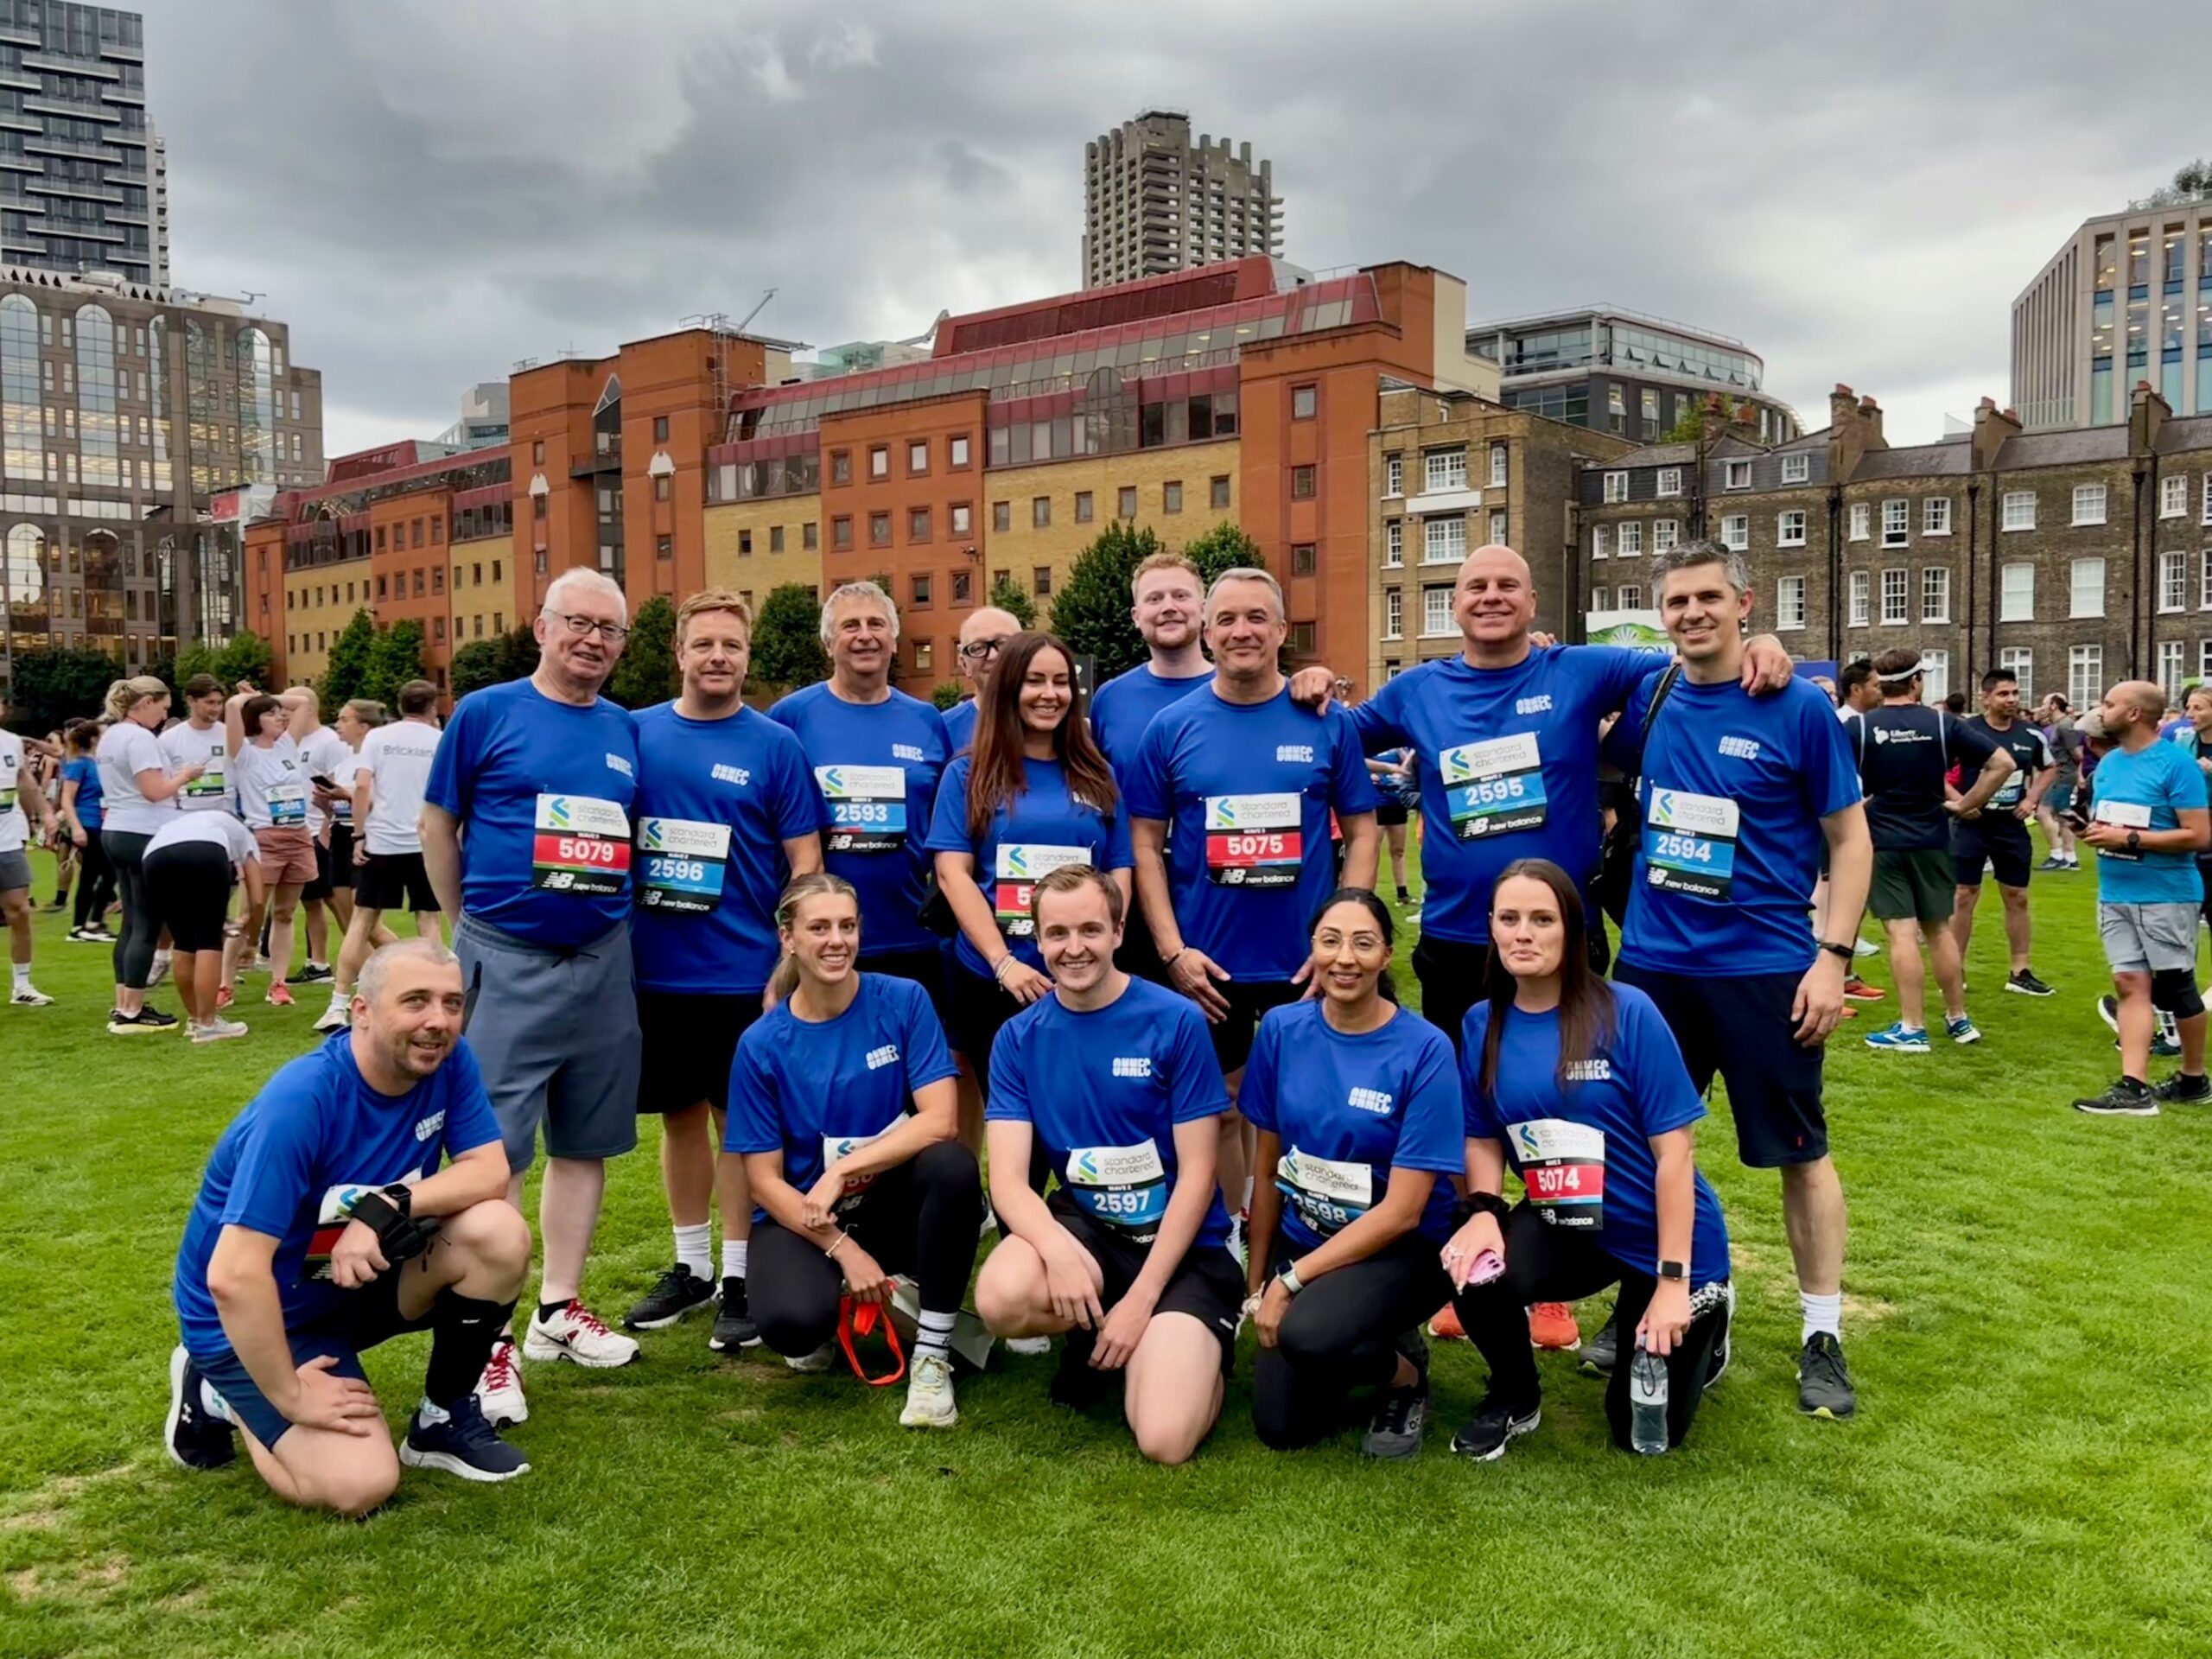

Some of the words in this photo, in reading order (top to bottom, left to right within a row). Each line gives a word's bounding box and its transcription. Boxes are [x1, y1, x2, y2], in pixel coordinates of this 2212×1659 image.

[1516, 695, 1553, 715] ONNEC
[1276, 745, 1313, 763] ONNEC
[1473, 743, 1522, 759] standard
[1719, 736, 1760, 760] ONNEC
[1475, 750, 1526, 767] chartered
[711, 763, 750, 785] ONNEC
[1465, 779, 1523, 806] 2595
[578, 804, 620, 818] standard
[835, 804, 888, 822] 2593
[1241, 802, 1287, 810] standard
[1241, 809, 1290, 819] chartered
[1680, 801, 1723, 816] standard
[577, 812, 623, 827] chartered
[1489, 822, 1507, 831] new
[1507, 816, 1542, 830] balance
[1678, 811, 1726, 826] chartered
[669, 827, 715, 839] standard
[559, 838, 613, 862] 5079
[668, 835, 717, 849] chartered
[1227, 835, 1284, 855] 5075
[1656, 836, 1712, 862] 2594
[1033, 852, 1079, 862] standard
[650, 859, 704, 882] 2596
[1263, 874, 1295, 884] balance
[573, 882, 590, 891] new
[590, 882, 619, 893] balance
[1665, 880, 1682, 889] new
[1682, 880, 1719, 896] balance
[676, 899, 710, 912] balance
[1112, 1058, 1151, 1077] ONNEC
[1566, 1059, 1611, 1081] ONNEC
[1348, 1086, 1393, 1115] ONNEC
[1103, 1151, 1151, 1166] standard
[1104, 1160, 1154, 1175] chartered
[1305, 1162, 1354, 1182] standard
[1306, 1171, 1358, 1191] chartered
[1536, 1167, 1580, 1192] 5074
[1093, 1190, 1149, 1213] 2597
[1132, 1234, 1156, 1244] balan
